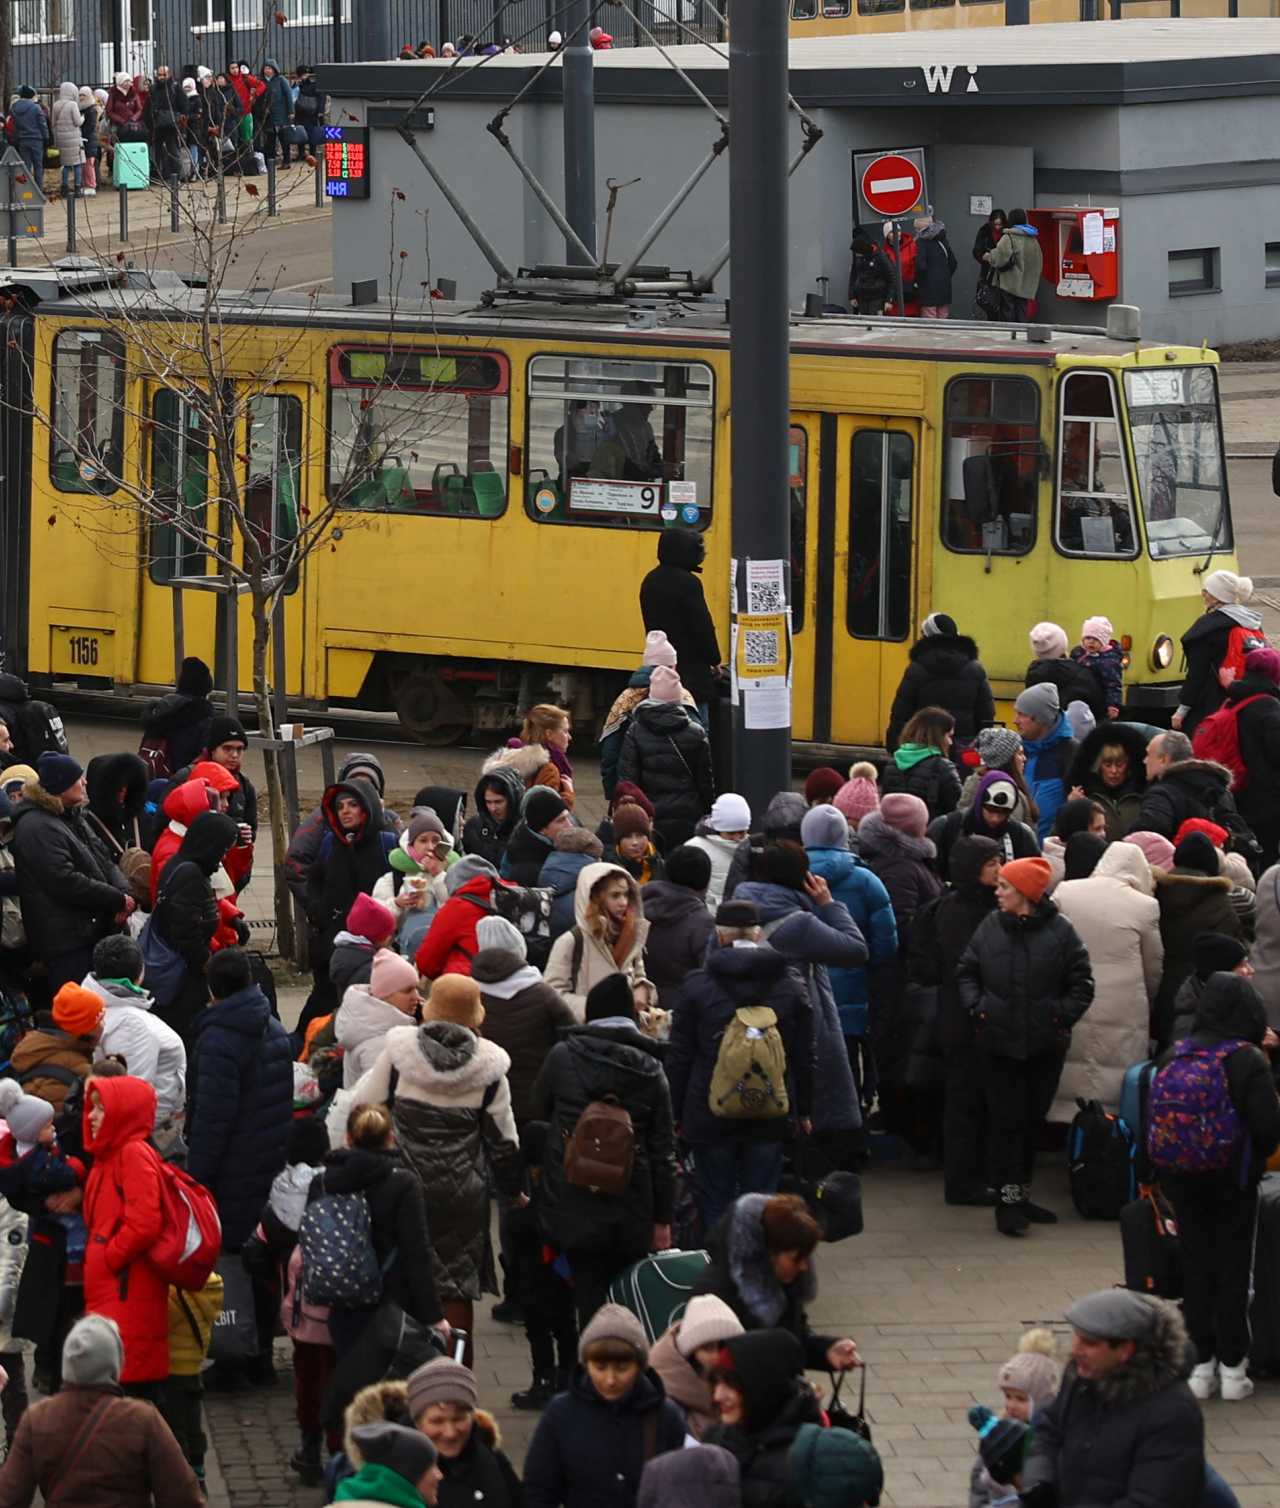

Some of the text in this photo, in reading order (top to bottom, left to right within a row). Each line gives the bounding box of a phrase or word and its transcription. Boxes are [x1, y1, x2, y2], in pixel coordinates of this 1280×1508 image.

[920, 64, 957, 93] W
[640, 486, 655, 510] 9
[69, 636, 99, 666] 1156
